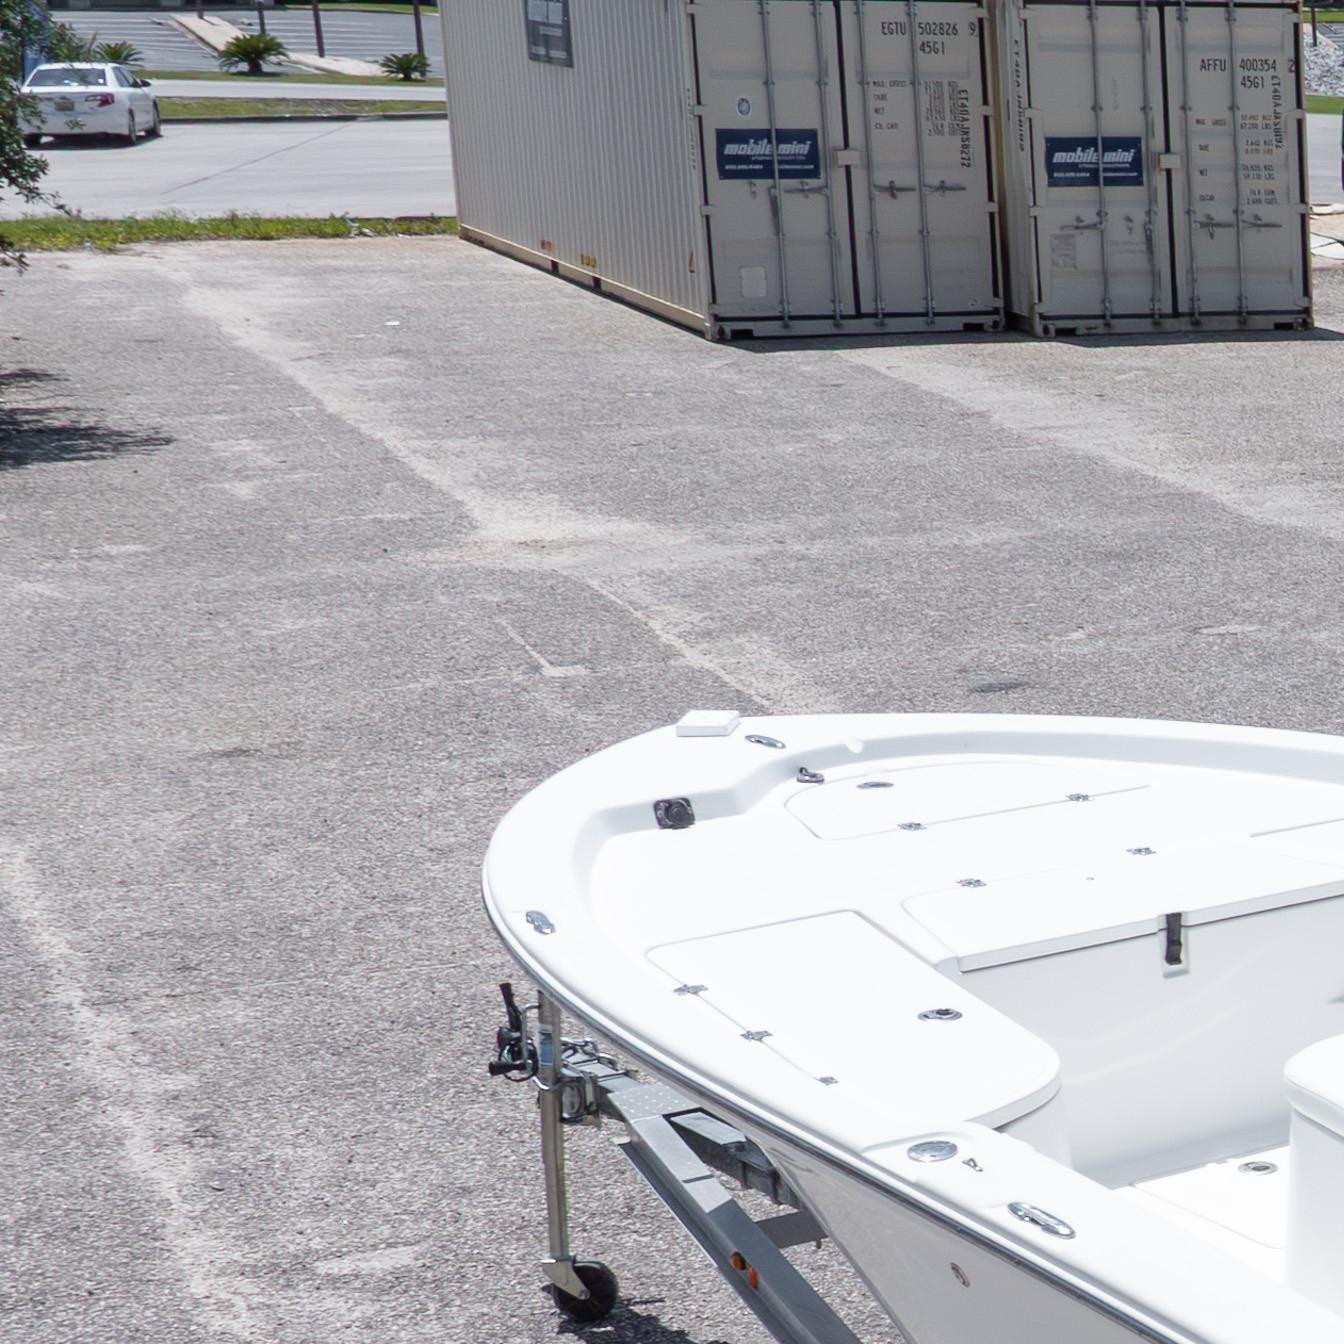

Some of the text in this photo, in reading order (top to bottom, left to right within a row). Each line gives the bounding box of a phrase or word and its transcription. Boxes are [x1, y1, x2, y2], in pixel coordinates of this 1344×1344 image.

[881, 22, 977, 36] EGTU 502826 9
[919, 41, 945, 55] 45G1
[1200, 58, 1226, 72] AFFU
[1239, 58, 1277, 72] 400354
[1240, 76, 1265, 89] 45G1
[724, 138, 812, 156] mobile mini
[1052, 147, 1136, 163] mobile mini
